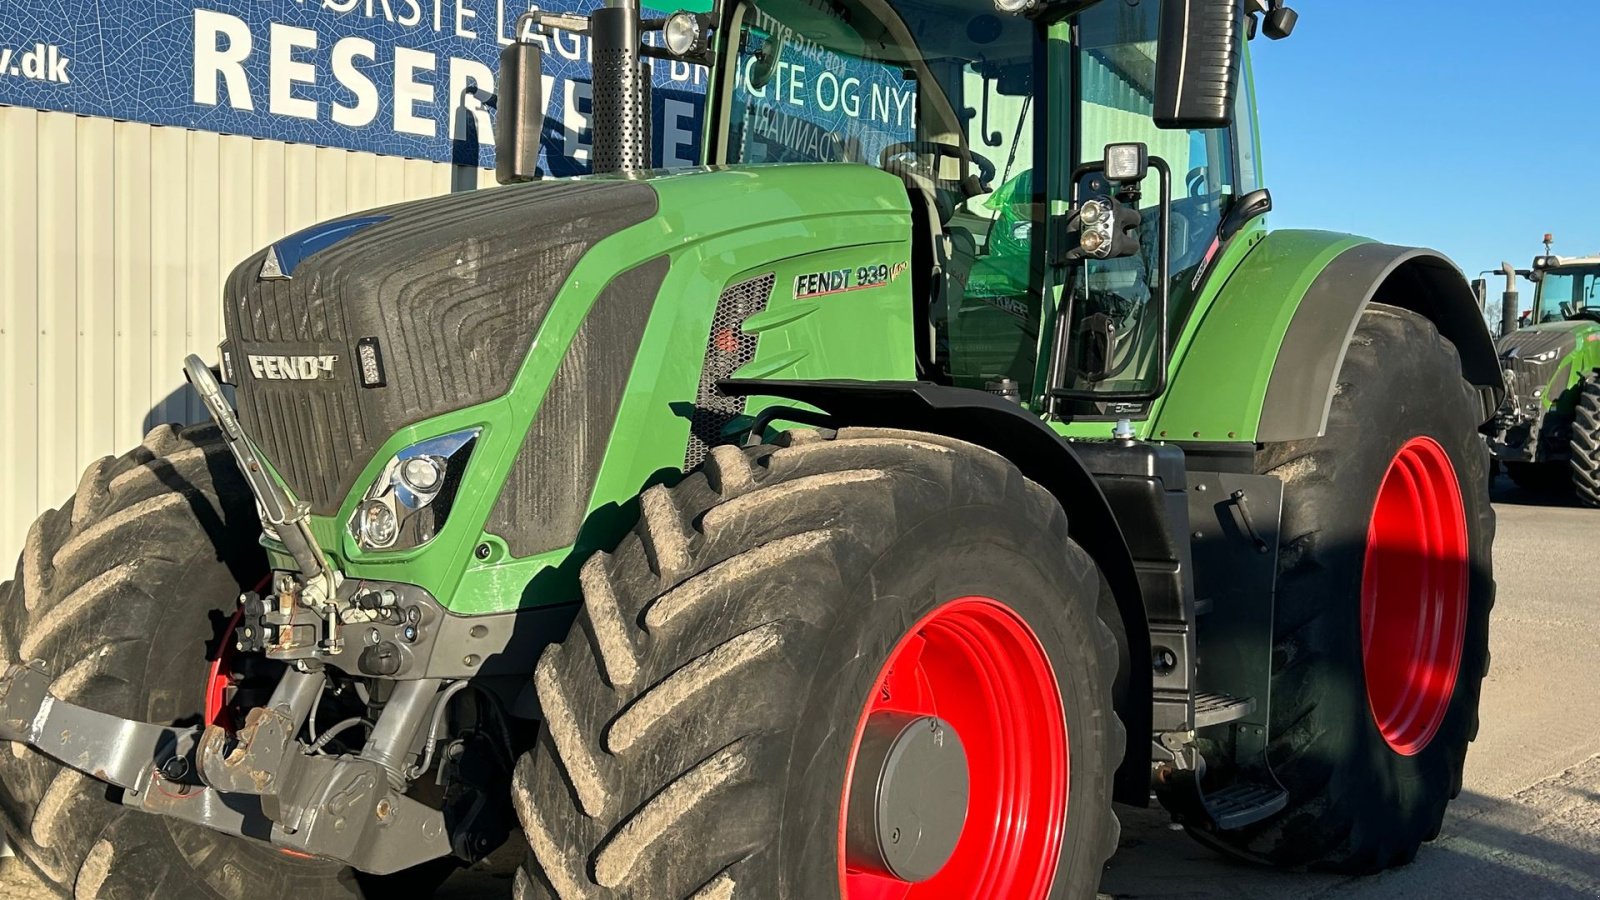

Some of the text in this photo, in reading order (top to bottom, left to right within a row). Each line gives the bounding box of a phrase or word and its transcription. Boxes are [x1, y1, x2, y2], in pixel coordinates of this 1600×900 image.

[816, 72, 860, 117] OG
[796, 268, 852, 297] FENDT
[856, 264, 888, 287] 939
[247, 354, 339, 380] FENDT
